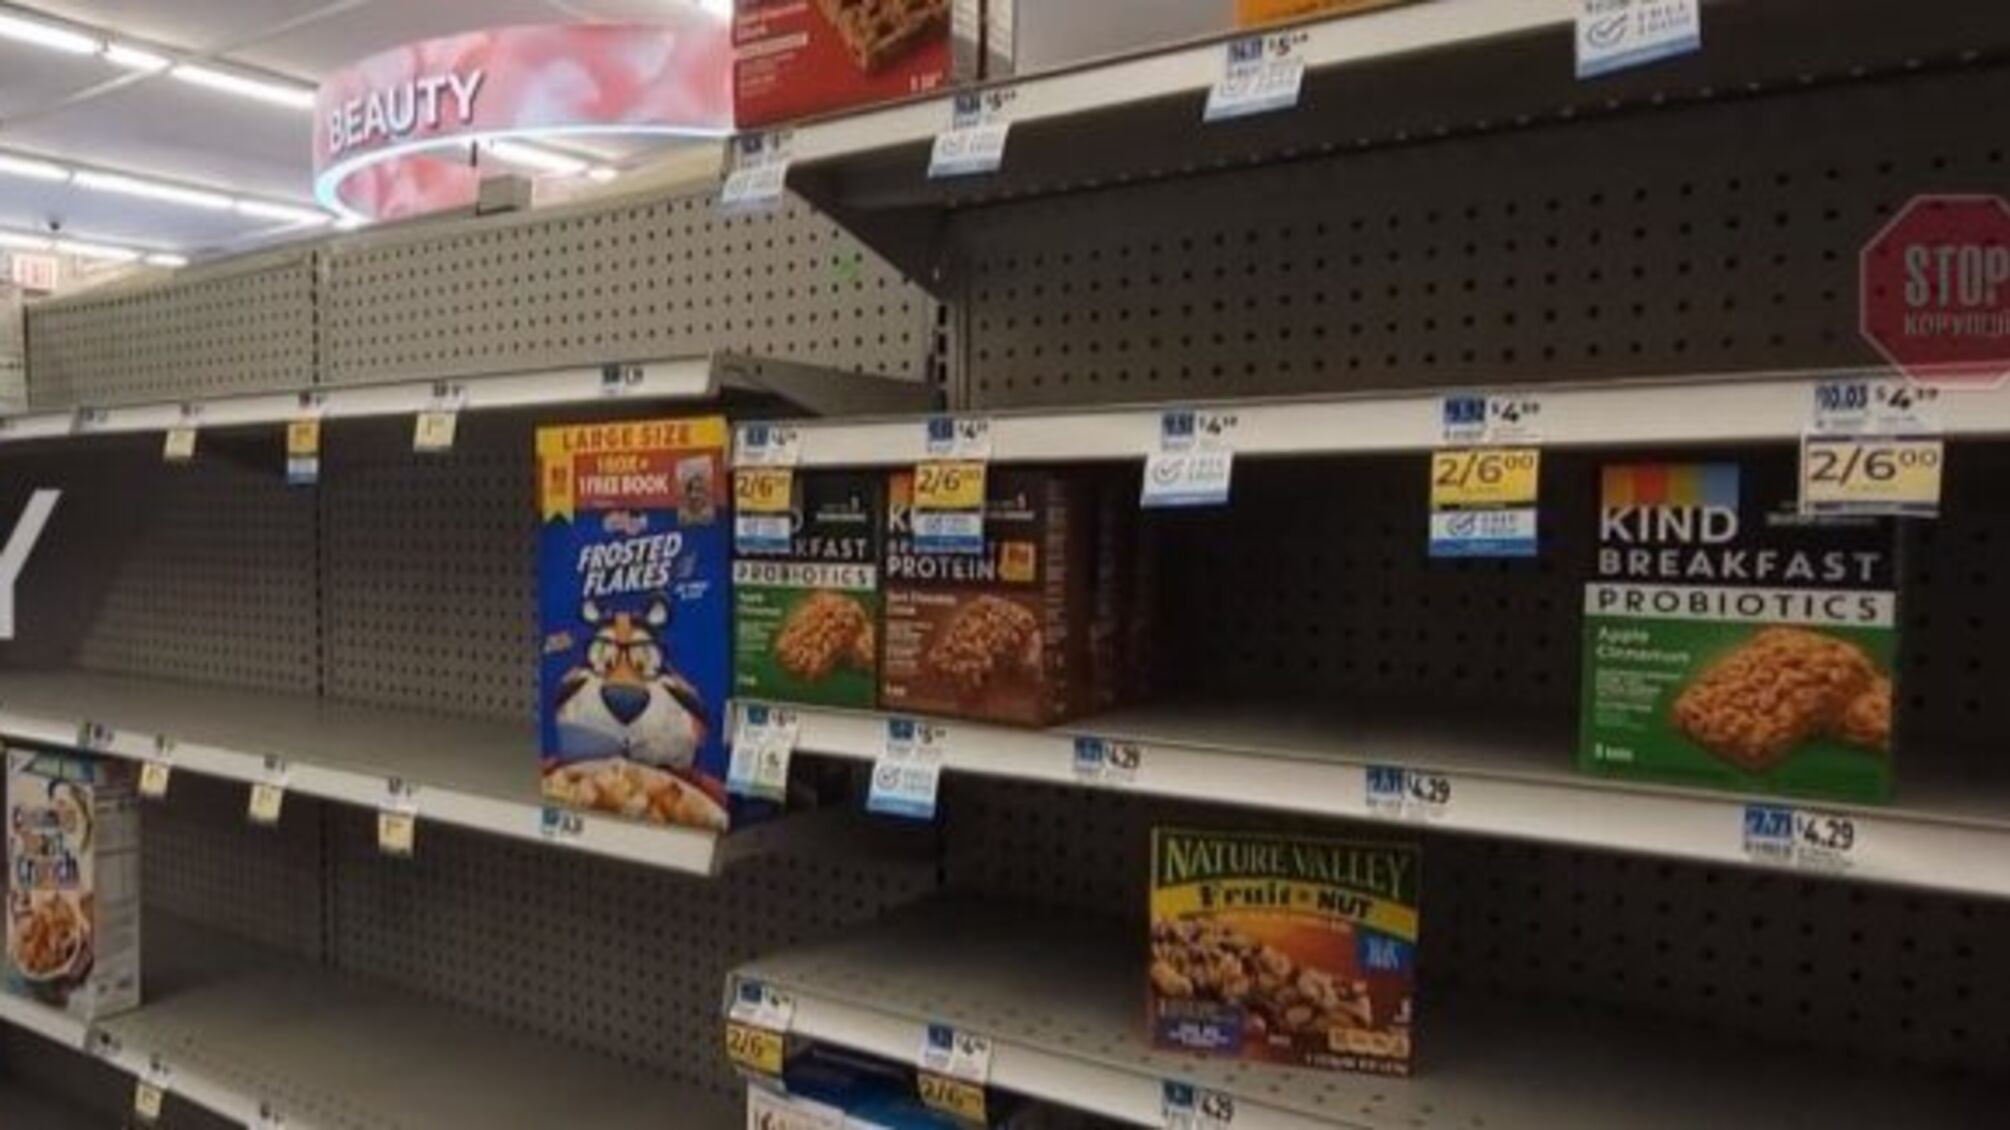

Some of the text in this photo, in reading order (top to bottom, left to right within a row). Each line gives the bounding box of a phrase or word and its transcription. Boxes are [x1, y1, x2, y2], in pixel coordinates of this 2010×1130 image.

[329, 70, 487, 153] BEAUTY
[561, 421, 690, 451] LARGE SIZE
[621, 473, 669, 492] BOOK
[1597, 503, 1739, 543] KIND
[577, 531, 683, 572] FROSTED
[885, 556, 995, 581] PROTEIN
[1598, 548, 1880, 582] BREAKFAST
[583, 561, 672, 597] FLAKES
[1598, 588, 1877, 621] PROBIOTICS
[1597, 625, 1650, 644] Apple
[1595, 645, 1691, 665] Cinnamon
[1163, 837, 1410, 900] NATURE VALLEY
[1199, 883, 1376, 922] Fruit NUT
